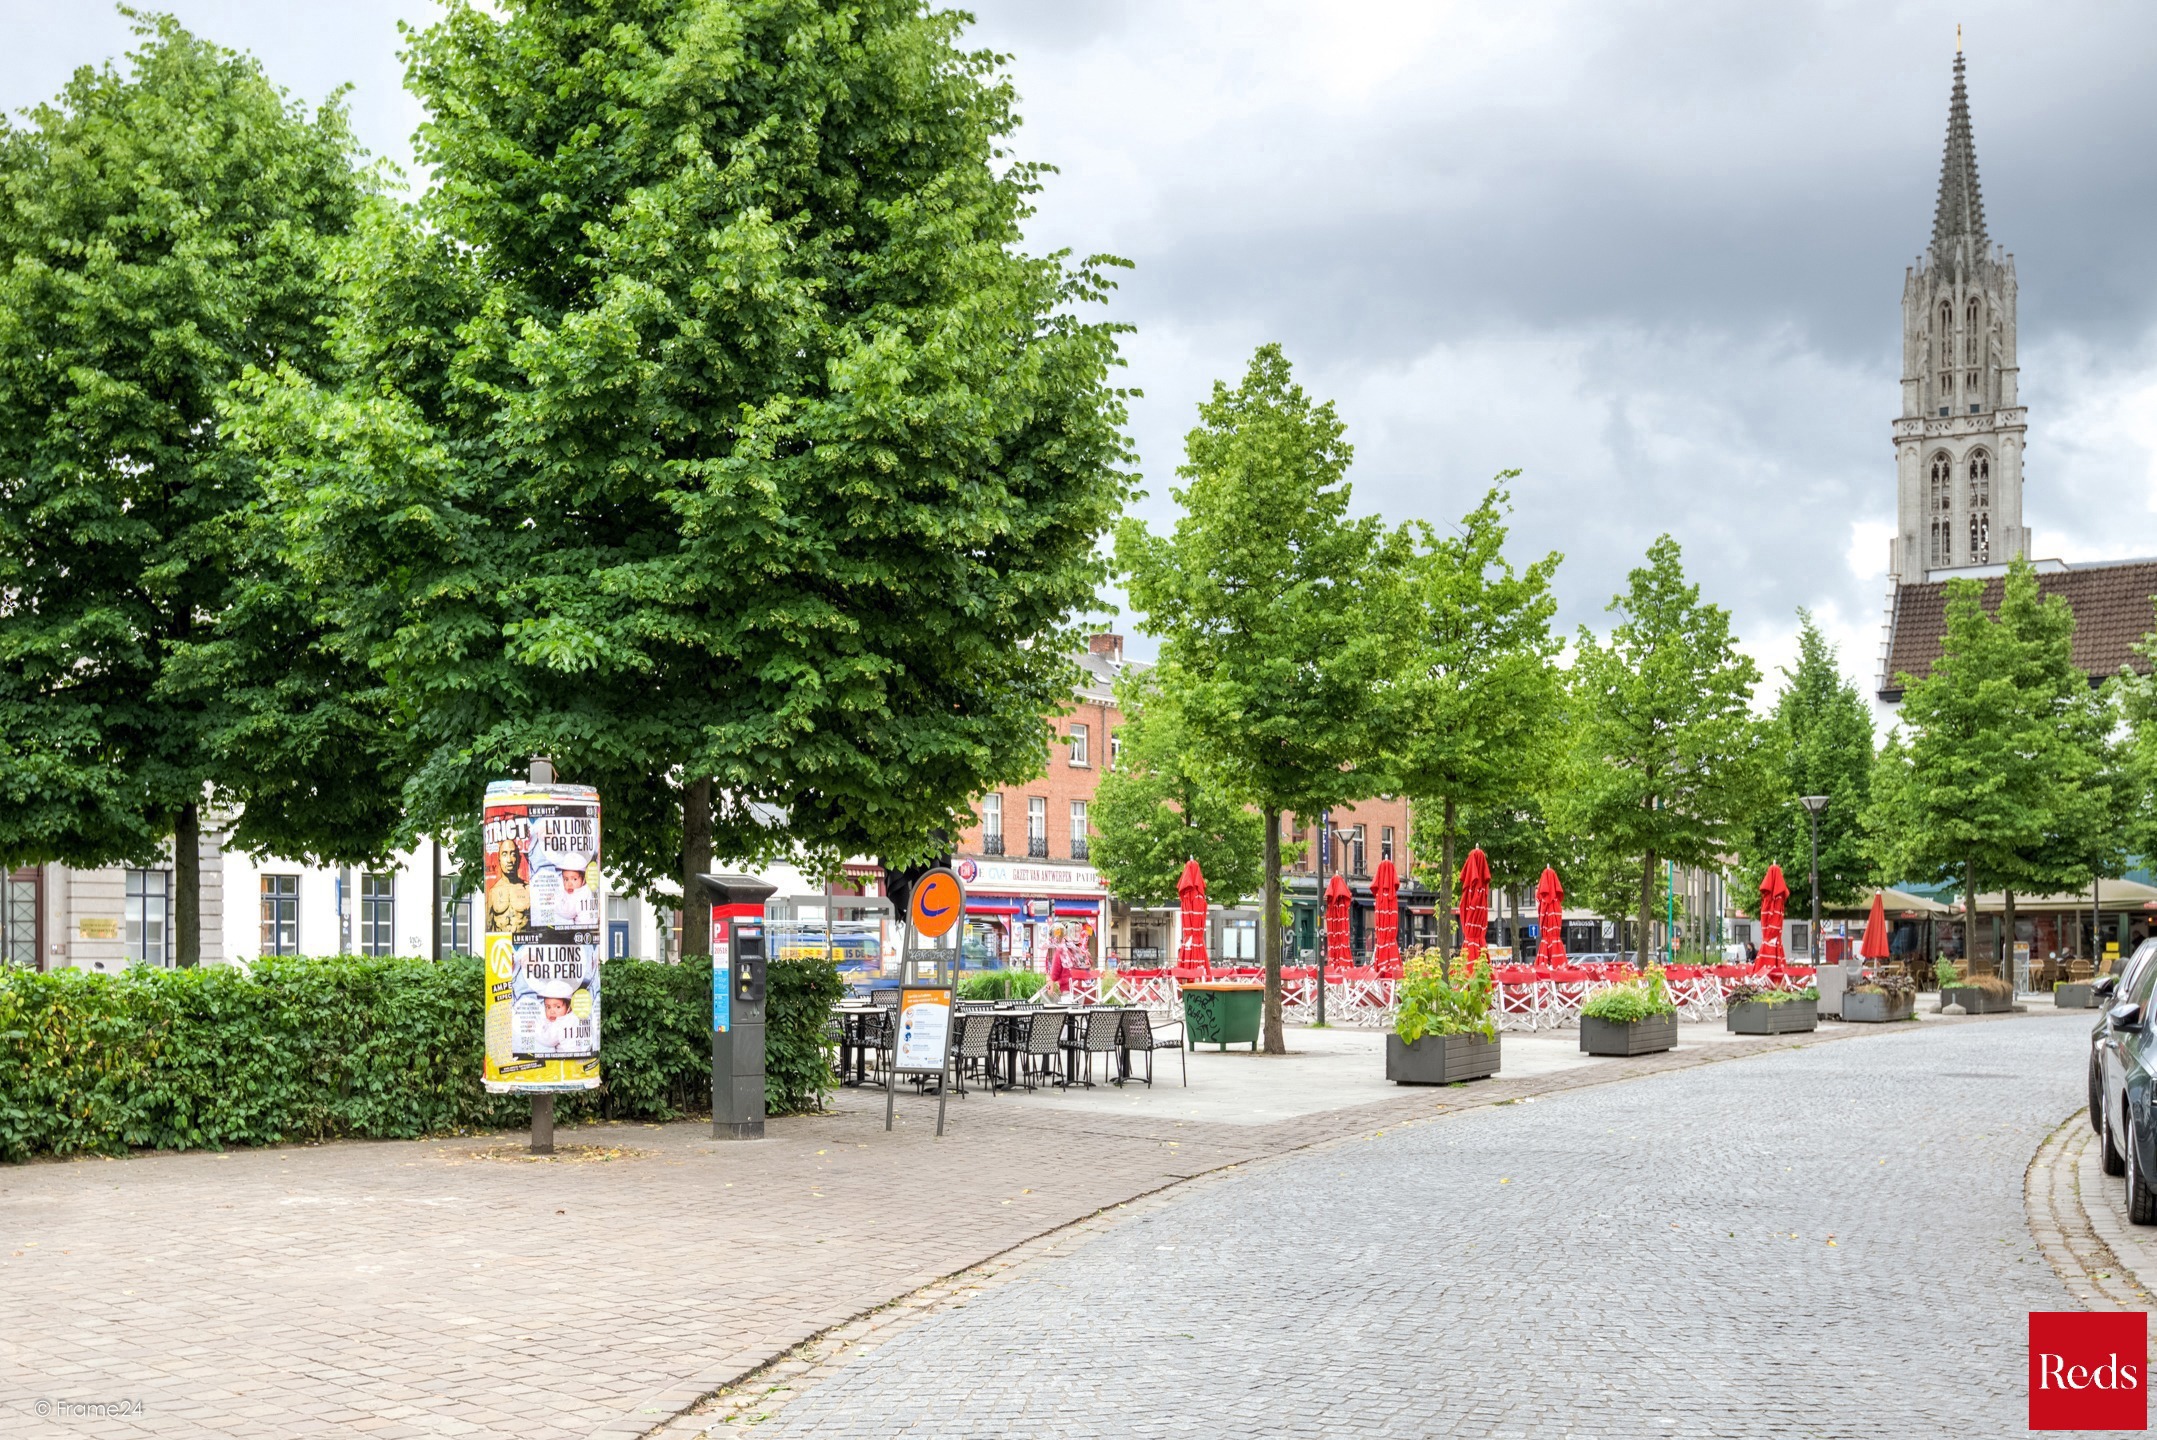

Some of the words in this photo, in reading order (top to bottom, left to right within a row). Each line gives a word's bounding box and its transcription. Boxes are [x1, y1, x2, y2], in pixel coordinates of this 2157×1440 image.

[546, 820, 560, 835] LN
[565, 819, 592, 835] LIONS
[544, 836, 566, 851] FOR
[571, 836, 593, 851] PERU
[1013, 868, 1029, 881] GAZET
[1030, 869, 1040, 881] VAN
[1041, 870, 1072, 882] ANTWERPEN
[528, 947, 544, 962] LN
[548, 947, 581, 962] LIONS
[527, 963, 550, 979] FOR
[554, 963, 582, 979] PERU
[564, 1027, 573, 1039] 11
[576, 1026, 591, 1039] JUNI
